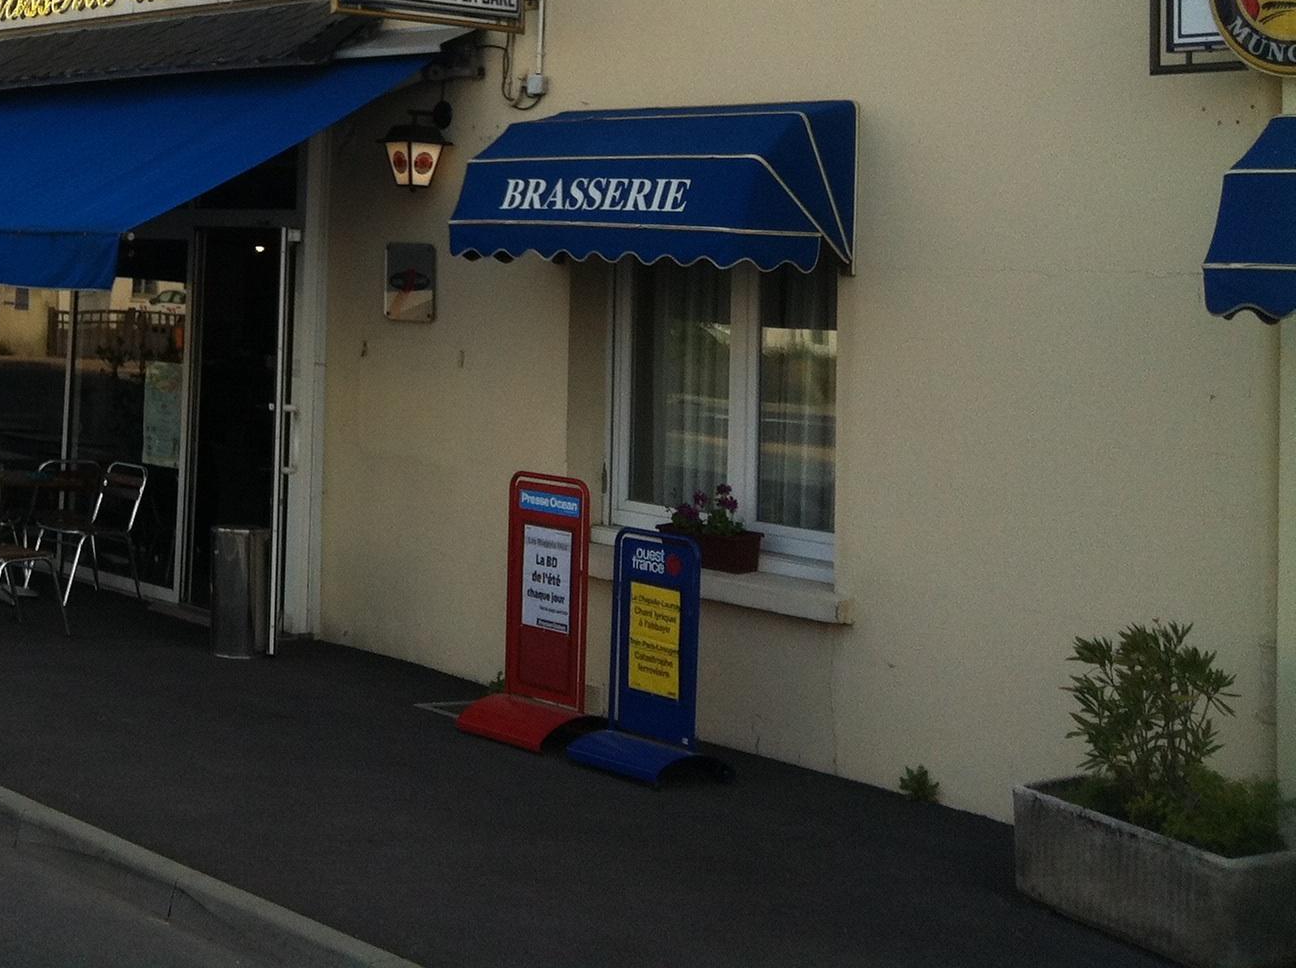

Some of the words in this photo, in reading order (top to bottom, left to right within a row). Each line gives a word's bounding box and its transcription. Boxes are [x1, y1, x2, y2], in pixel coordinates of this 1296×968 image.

[498, 177, 691, 212] BRASSERIE
[521, 492, 549, 507] Presse
[536, 553, 545, 566] La
[546, 555, 558, 568] BD
[636, 547, 664, 563] ouest
[632, 555, 664, 575] france
[532, 571, 541, 583] de
[542, 572, 561, 586] l'été
[527, 587, 550, 602] chaque
[551, 592, 565, 603] jour
